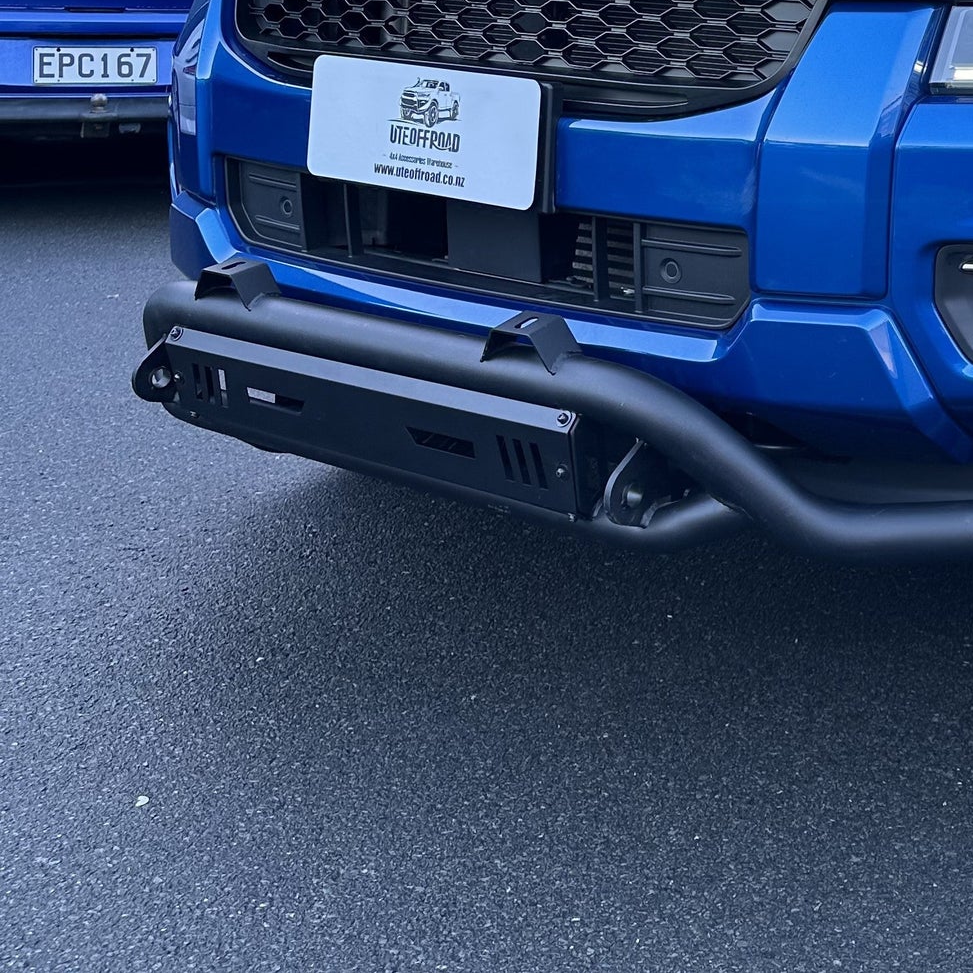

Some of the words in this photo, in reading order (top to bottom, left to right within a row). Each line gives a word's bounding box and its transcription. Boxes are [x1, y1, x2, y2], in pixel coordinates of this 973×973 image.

[38, 52, 152, 78] EPC167
[390, 124, 460, 153] UTEOFFROAD
[374, 163, 465, 187] www.uteoffroad.co.nz
